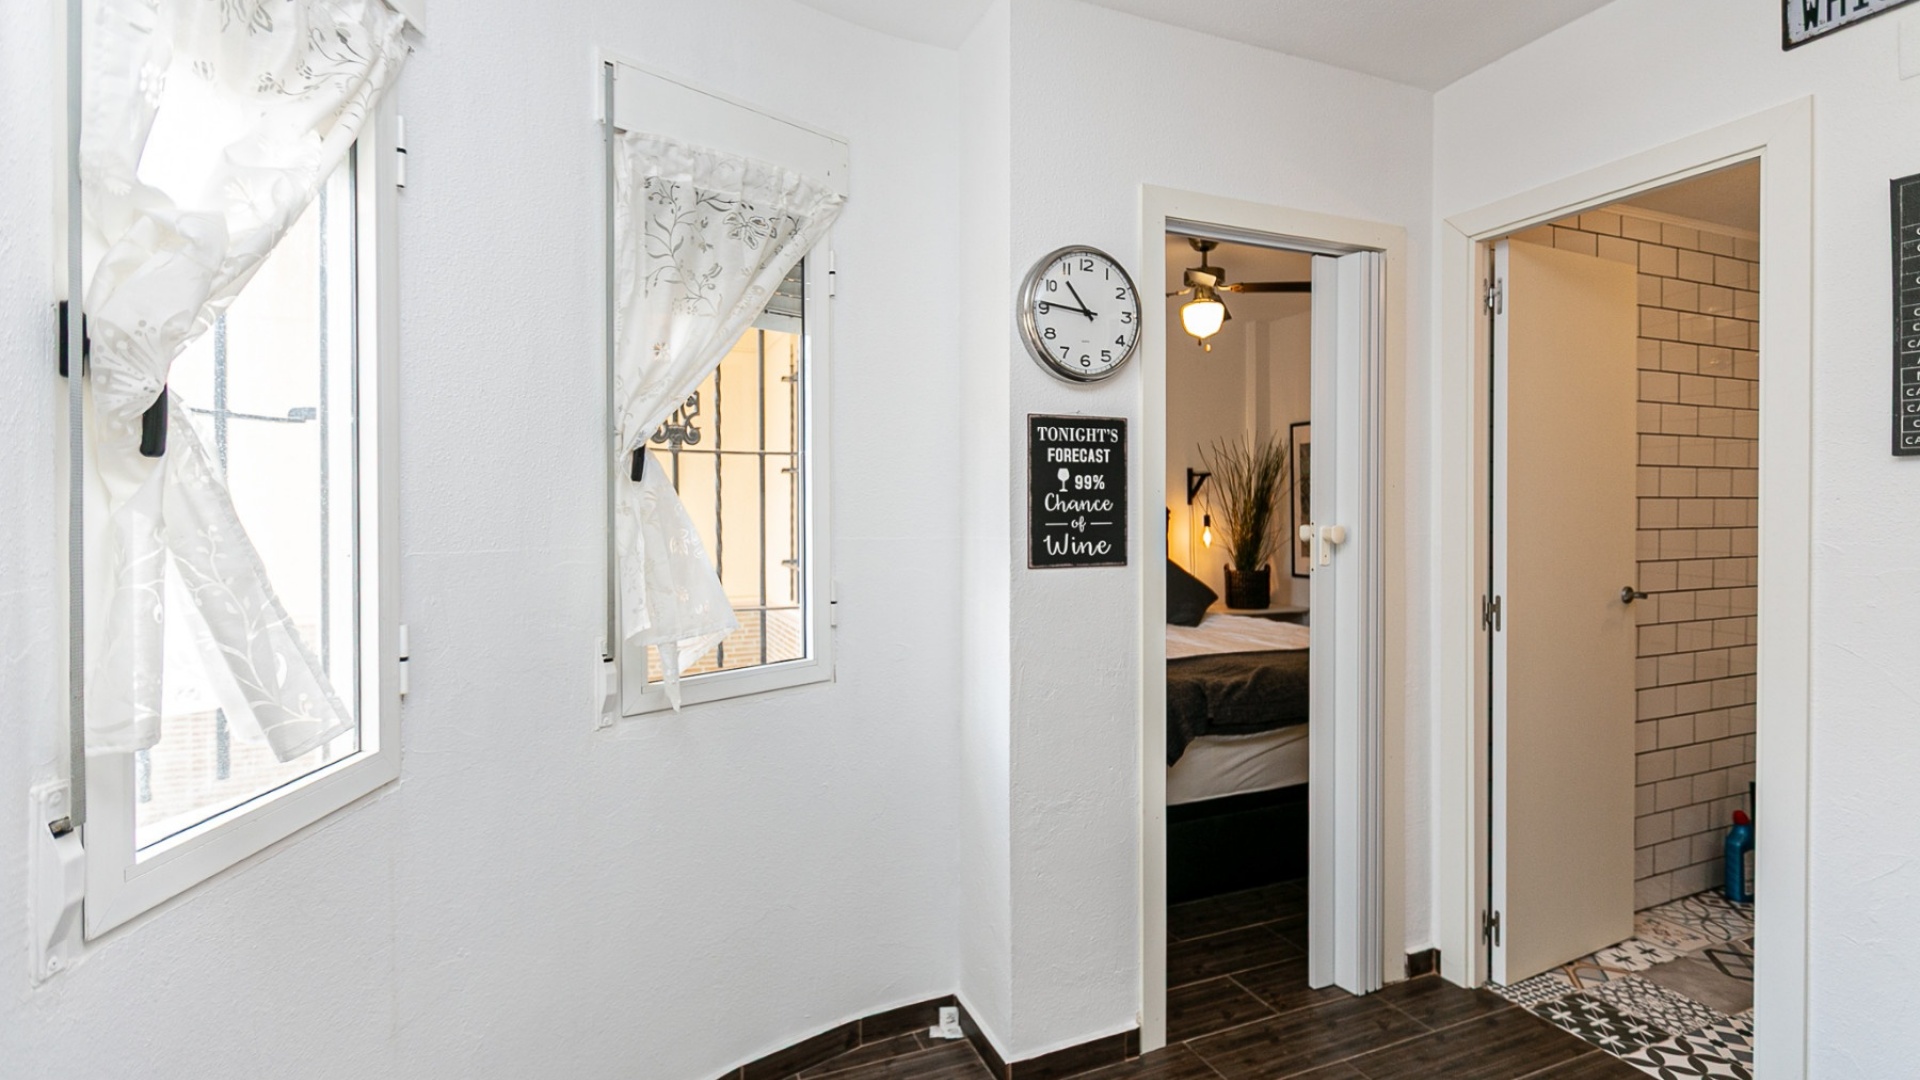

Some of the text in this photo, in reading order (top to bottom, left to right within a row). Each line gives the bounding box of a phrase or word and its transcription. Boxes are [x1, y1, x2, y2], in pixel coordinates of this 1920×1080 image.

[1063, 262, 1071, 275] 11
[1080, 258, 1094, 272] 12
[1046, 279, 1057, 292] 10
[1115, 287, 1126, 300] 2
[1038, 301, 1050, 315] 9
[1120, 311, 1132, 324] 3
[1044, 327, 1056, 340] 8
[1115, 335, 1125, 347] 4
[1060, 346, 1070, 359] 7
[1101, 350, 1112, 363] 5
[1080, 354, 1091, 367] 6
[1037, 426, 1119, 443] TONIGHT'S
[1047, 447, 1111, 463] FORECAST
[1074, 474, 1105, 490] 99%
[1044, 492, 1114, 513] Chance
[1071, 515, 1087, 533] of
[1043, 532, 1112, 557] Wine
